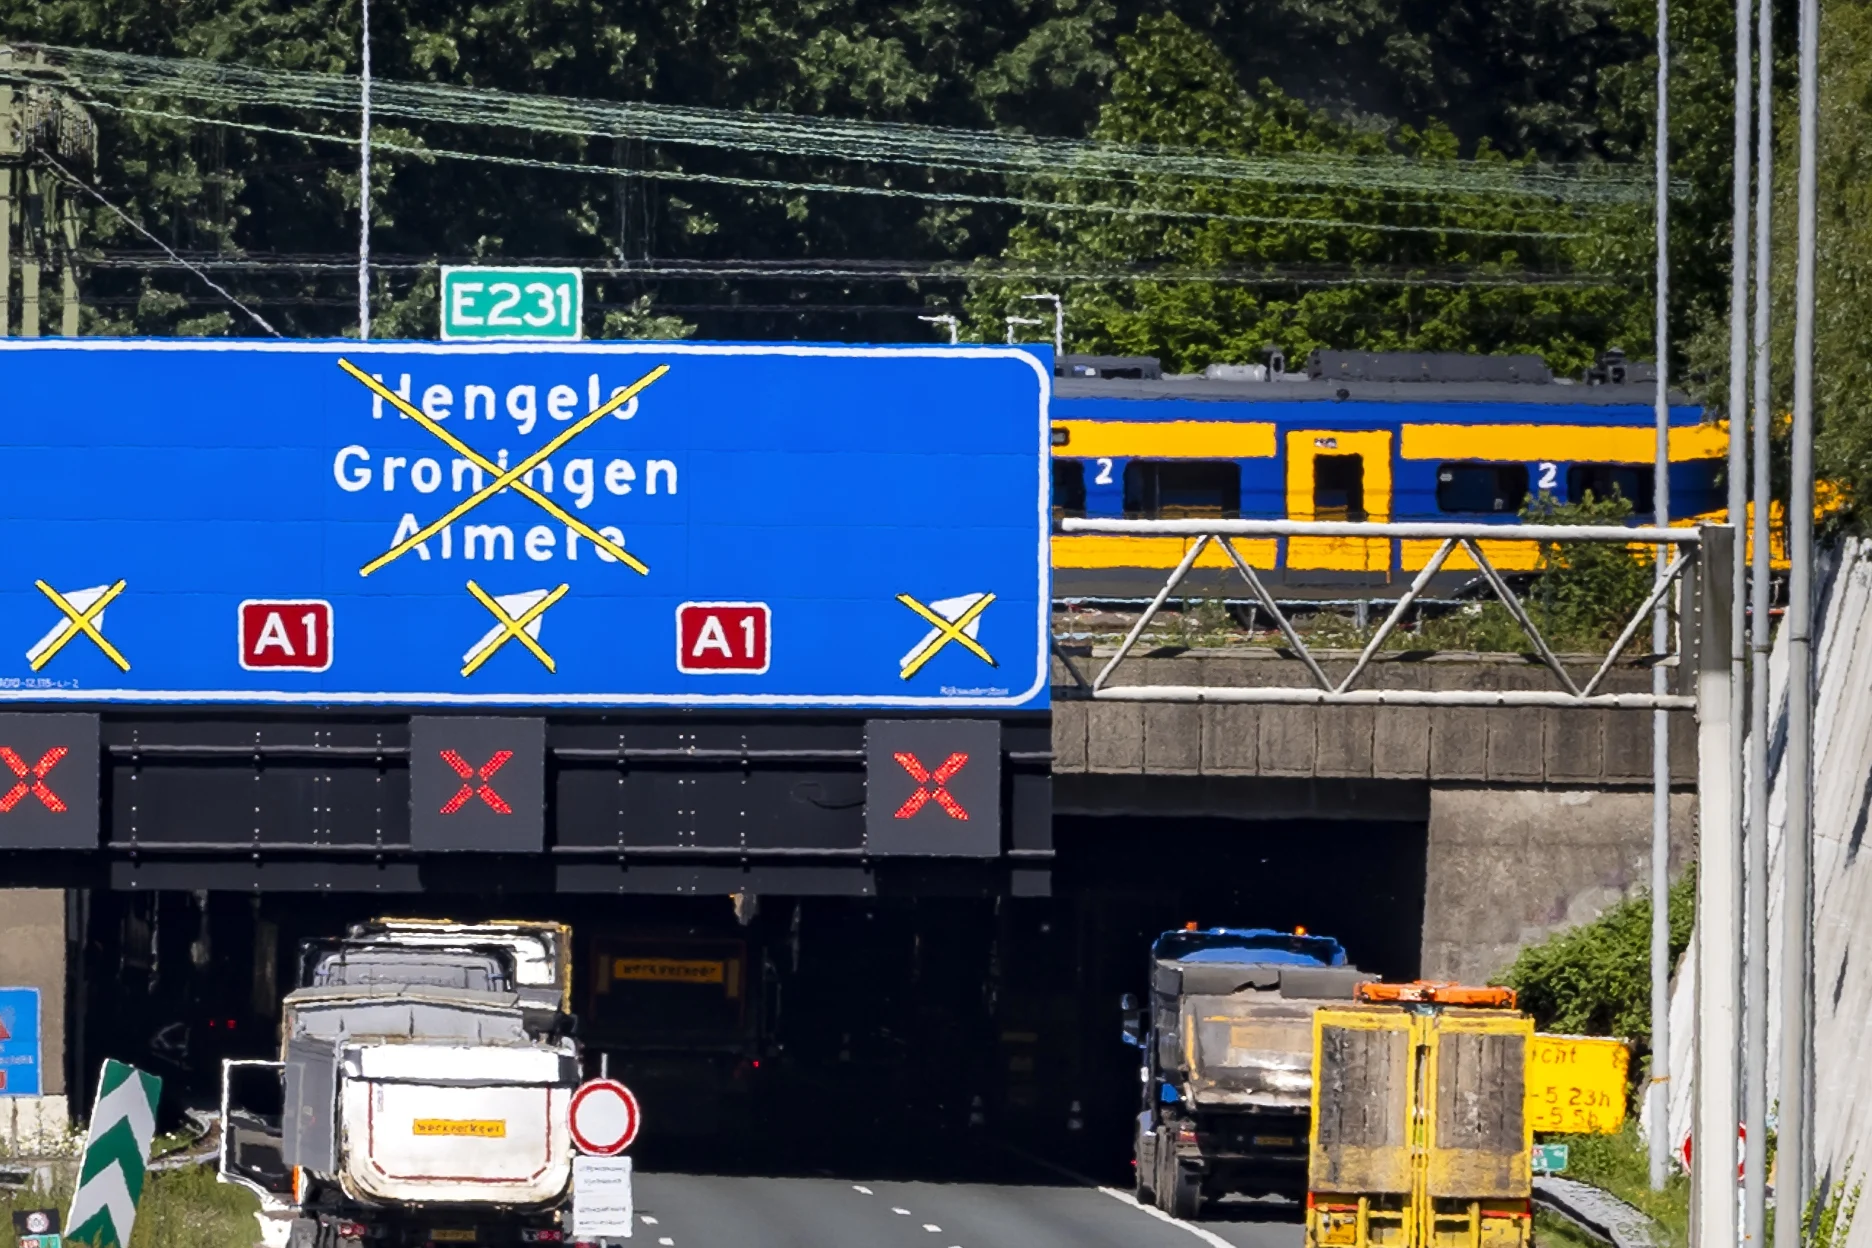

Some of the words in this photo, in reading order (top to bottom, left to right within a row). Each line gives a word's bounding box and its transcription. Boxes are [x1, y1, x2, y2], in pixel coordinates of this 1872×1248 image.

[451, 281, 575, 325] E231
[369, 371, 641, 436] Hengelo
[333, 445, 680, 506] Groningen
[1095, 458, 1114, 485] 2
[1538, 462, 1558, 490] 2
[388, 511, 628, 563] Almere
[253, 614, 319, 658] A1
[693, 616, 758, 660] A1
